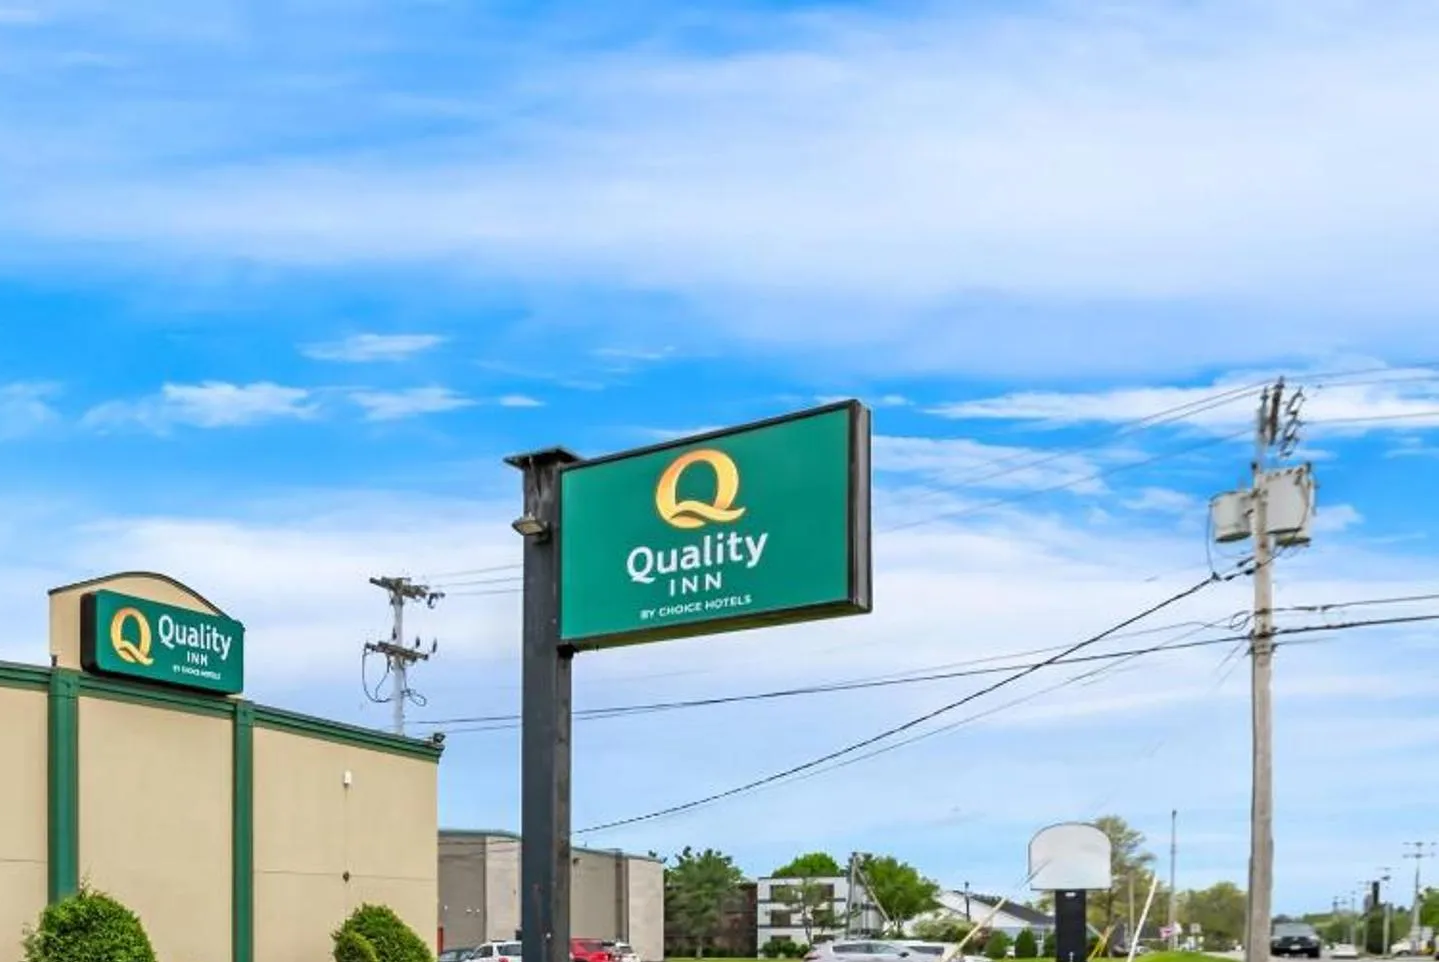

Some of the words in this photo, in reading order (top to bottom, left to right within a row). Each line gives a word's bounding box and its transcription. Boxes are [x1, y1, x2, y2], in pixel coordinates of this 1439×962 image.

[655, 449, 746, 528] Q
[626, 531, 768, 583] Quality
[640, 608, 656, 620] BY
[658, 601, 702, 617] CHOICE
[705, 594, 753, 611] HOTELS
[669, 571, 722, 597] INN
[111, 607, 155, 666] Q
[158, 613, 233, 661] Quality
[186, 650, 209, 667] INN
